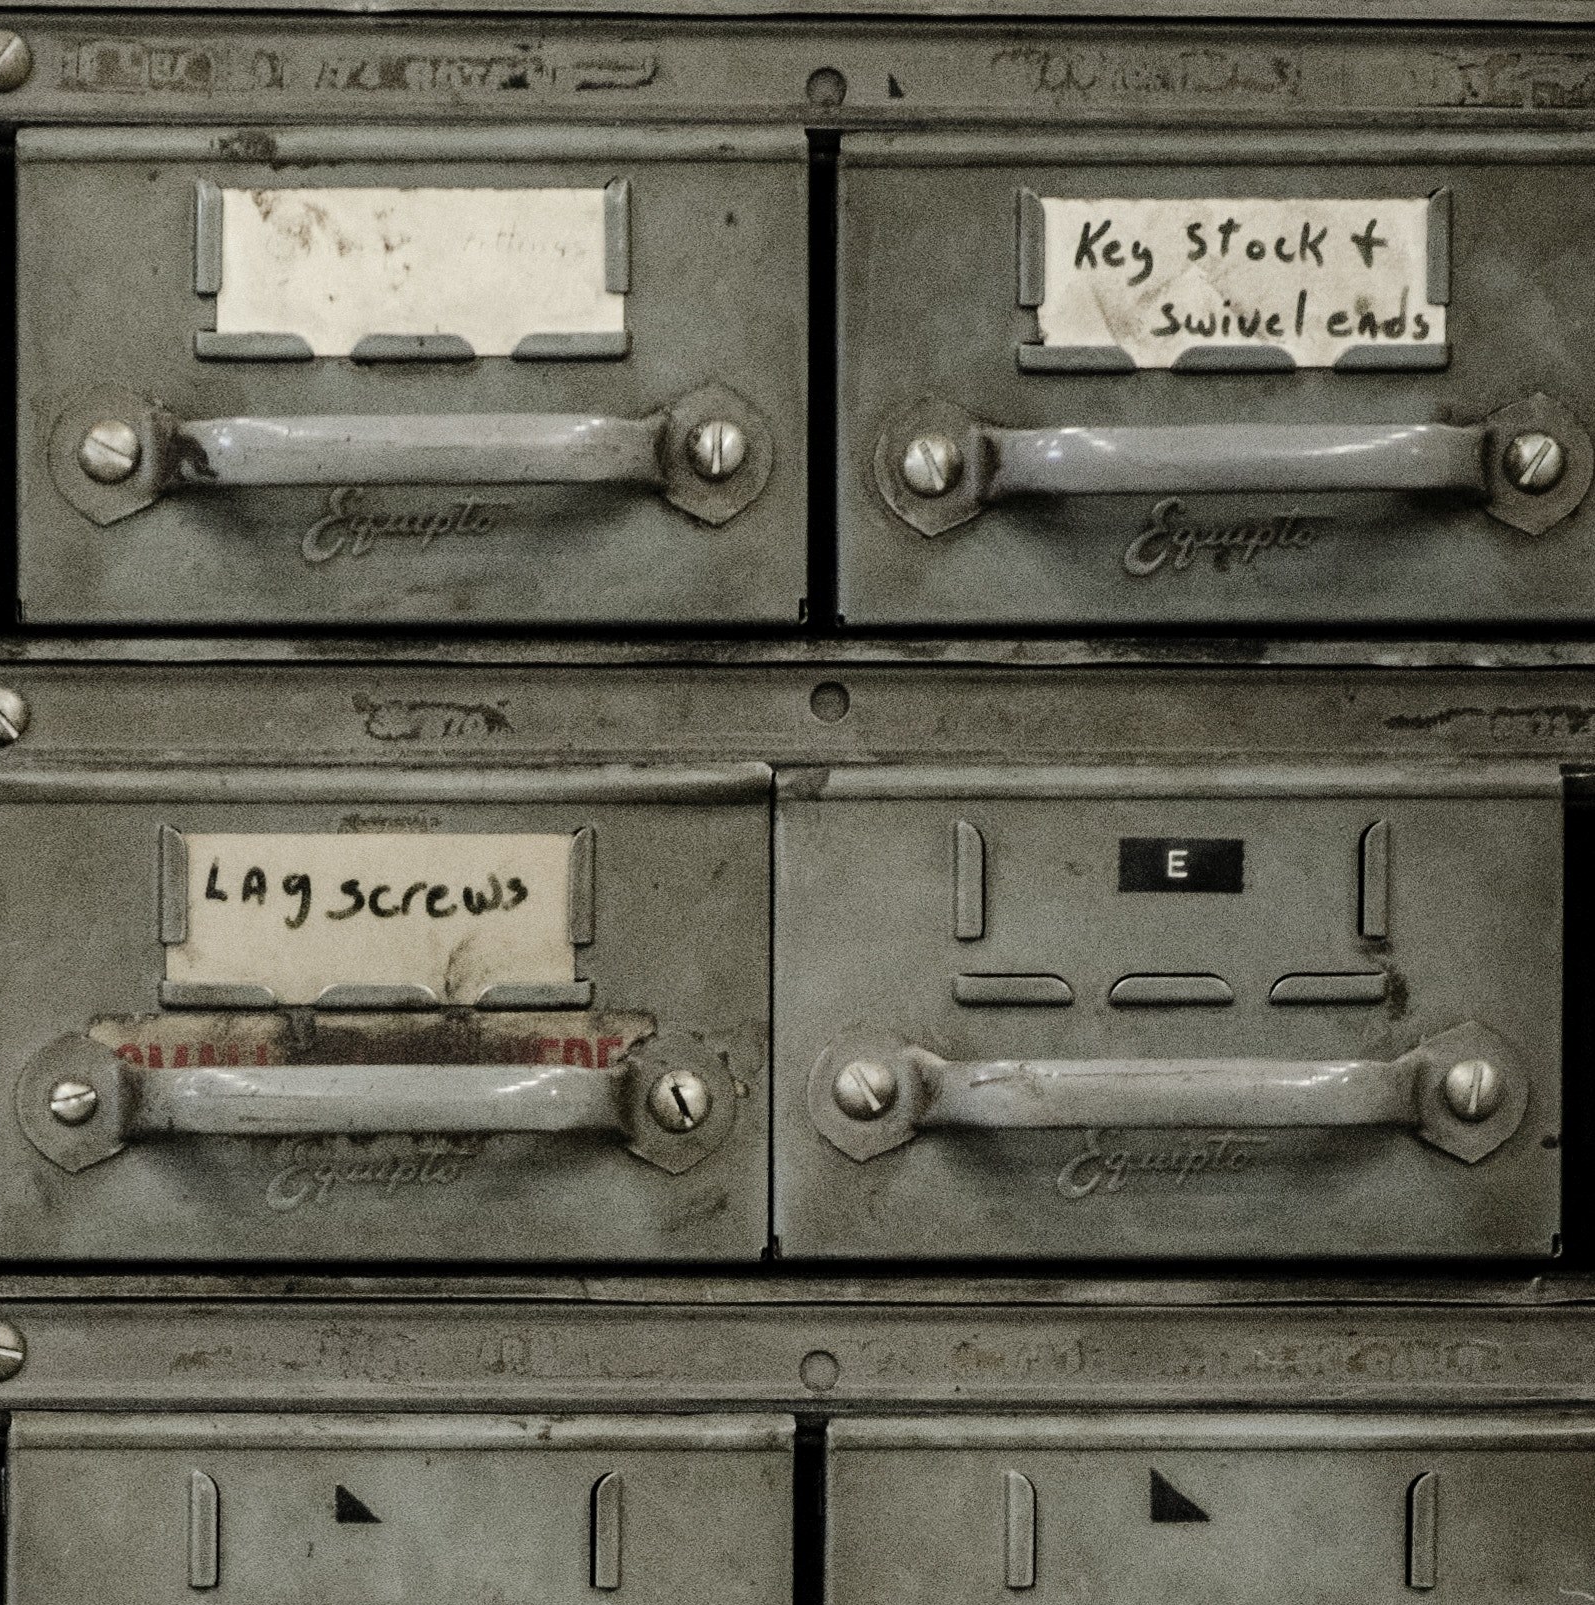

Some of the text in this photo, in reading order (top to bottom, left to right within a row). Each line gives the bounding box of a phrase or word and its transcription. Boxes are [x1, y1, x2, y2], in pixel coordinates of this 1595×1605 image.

[1075, 219, 1154, 284] Key
[1327, 286, 1430, 340] ends
[1166, 849, 1189, 878] E
